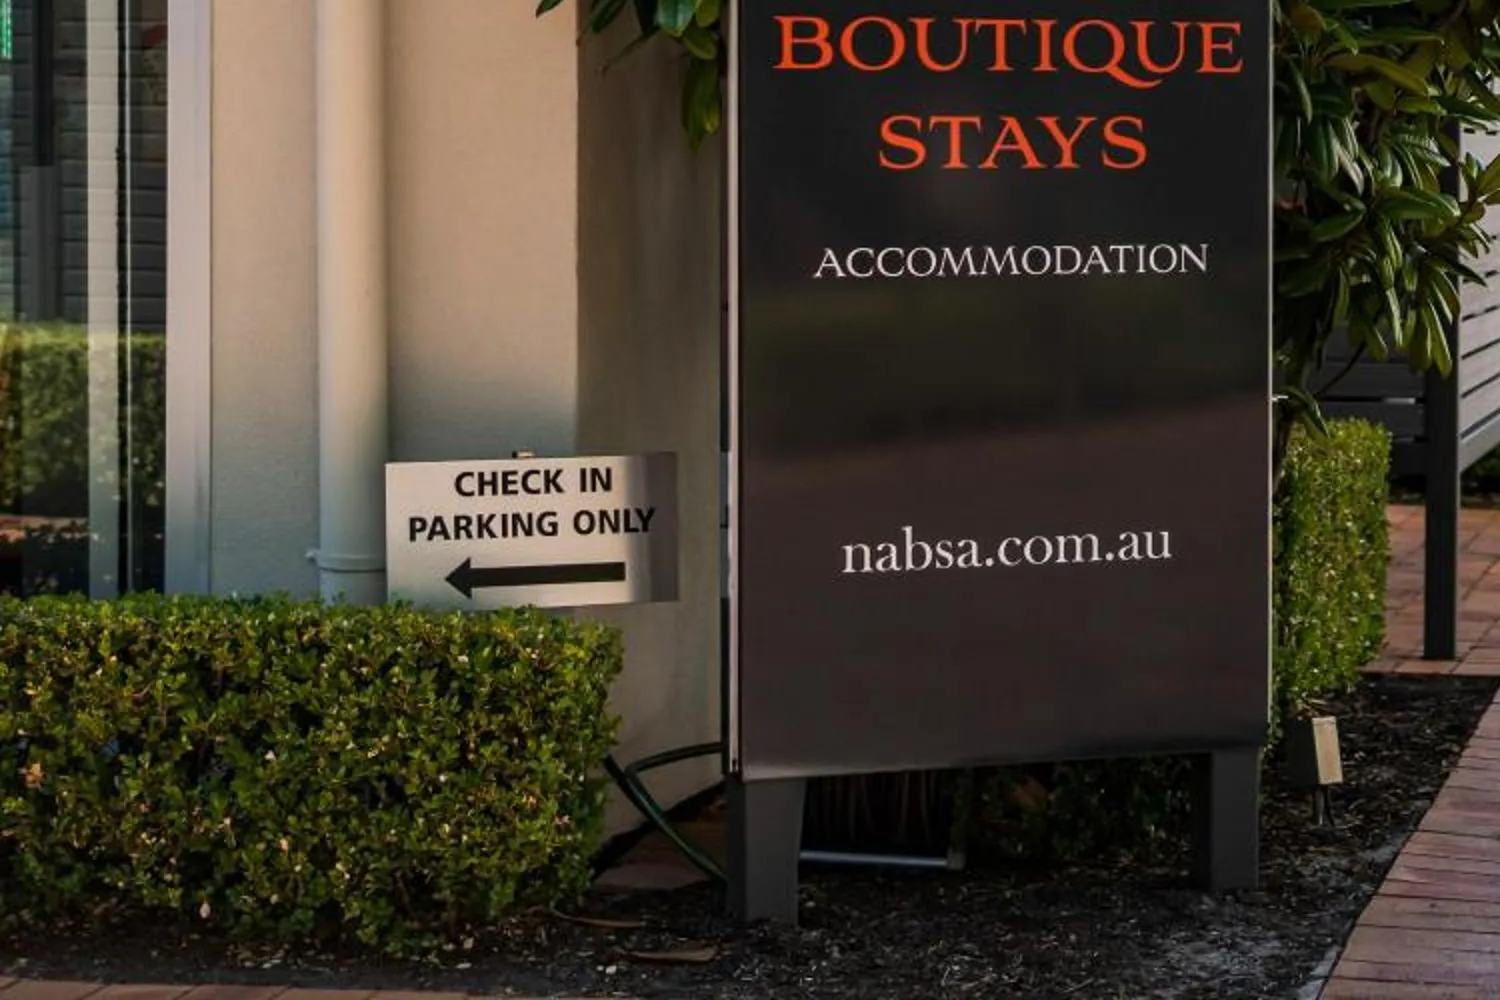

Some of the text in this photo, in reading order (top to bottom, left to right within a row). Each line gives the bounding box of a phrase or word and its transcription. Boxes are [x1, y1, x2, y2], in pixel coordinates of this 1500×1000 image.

[773, 15, 1243, 89] BOUTIQUE
[878, 115, 1147, 170] STAYS
[813, 243, 1209, 279] ACCOMMODATION
[454, 467, 612, 497] CHECK IN
[408, 506, 656, 542] PARKING ONLY
[841, 525, 1173, 573] nabsa.com.au
